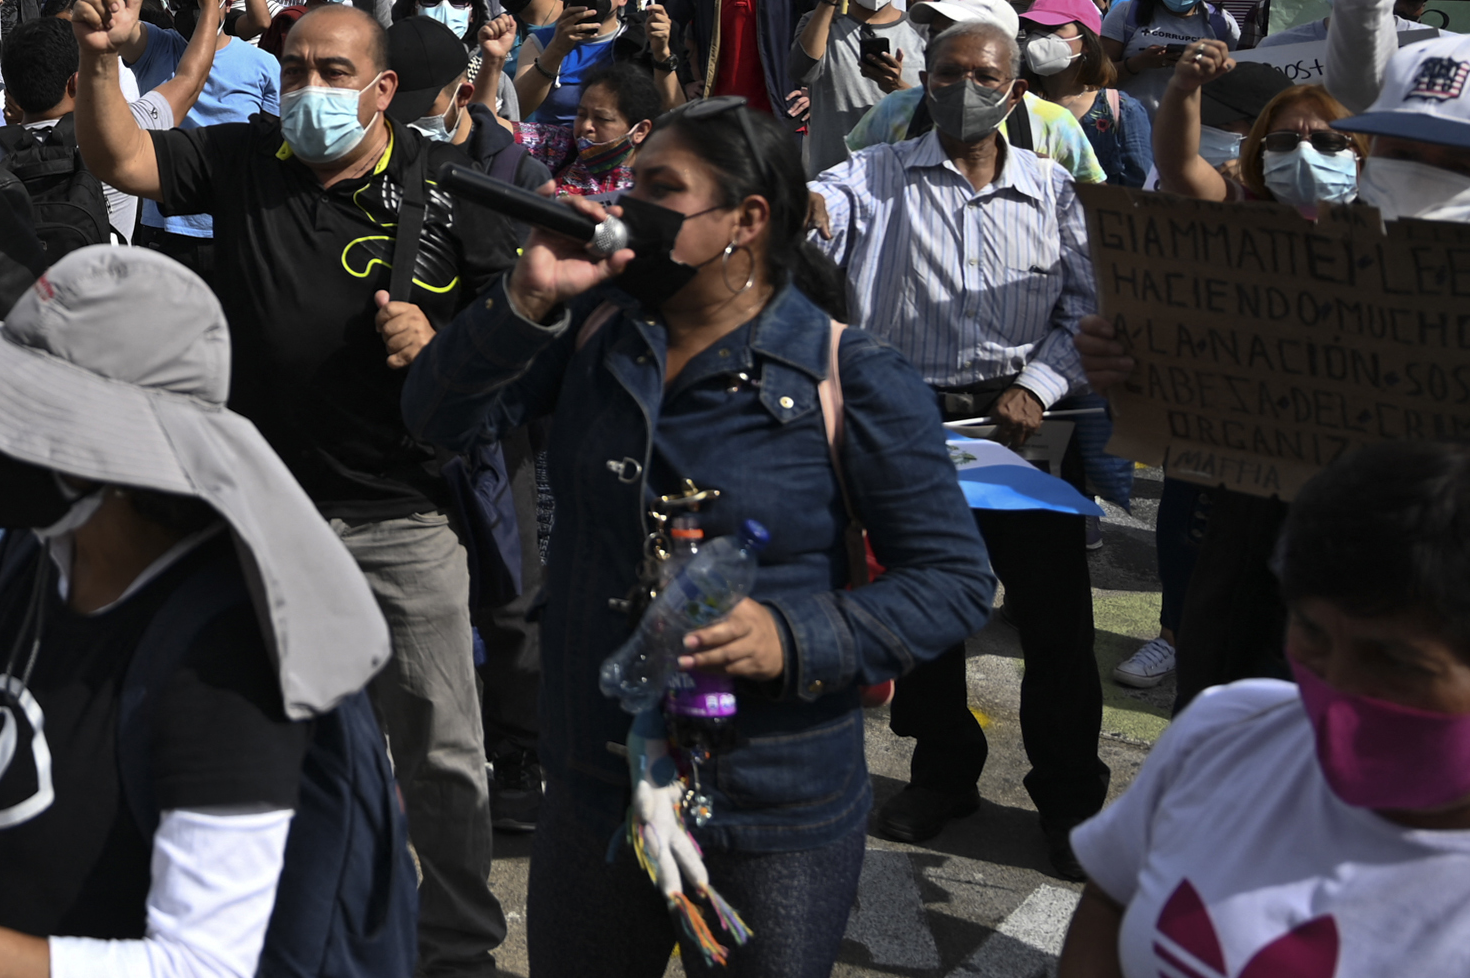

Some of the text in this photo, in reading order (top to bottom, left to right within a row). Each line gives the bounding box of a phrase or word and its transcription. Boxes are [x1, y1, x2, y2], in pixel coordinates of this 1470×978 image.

[1097, 208, 1356, 286] GIAMMATTEI
[1112, 262, 1320, 327] HACIENDO
[1146, 319, 1197, 357] LA
[1291, 387, 1367, 433] DEL
